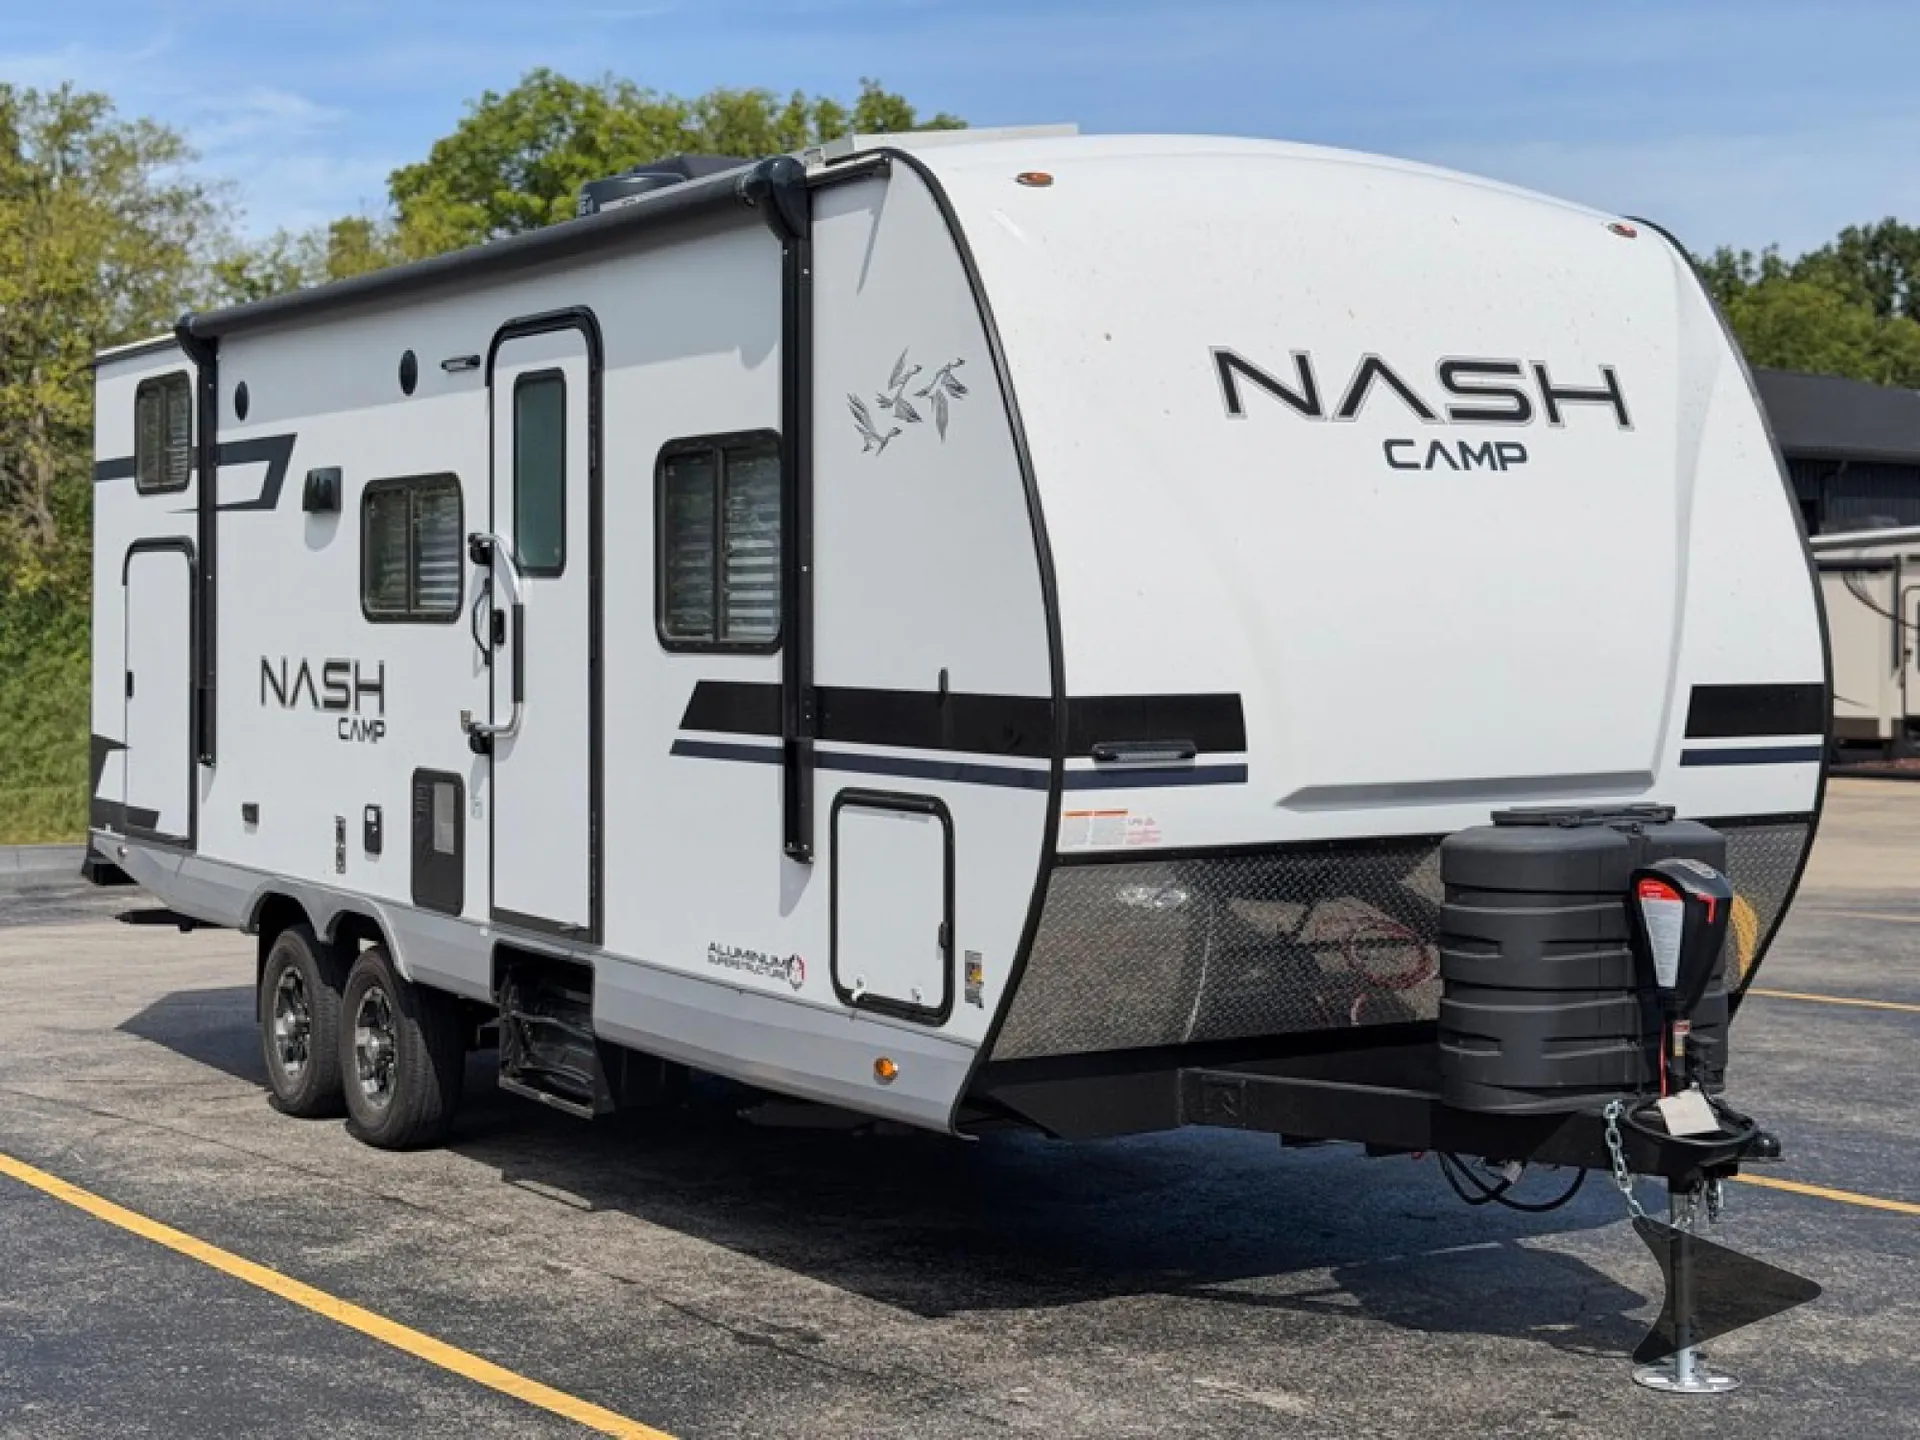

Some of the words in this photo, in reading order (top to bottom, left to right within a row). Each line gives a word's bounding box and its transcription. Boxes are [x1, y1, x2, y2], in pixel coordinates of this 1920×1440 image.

[1209, 346, 1635, 432] NASH
[1383, 438, 1528, 471] CAMP
[260, 655, 385, 717] NASH
[338, 717, 386, 743] CAMP
